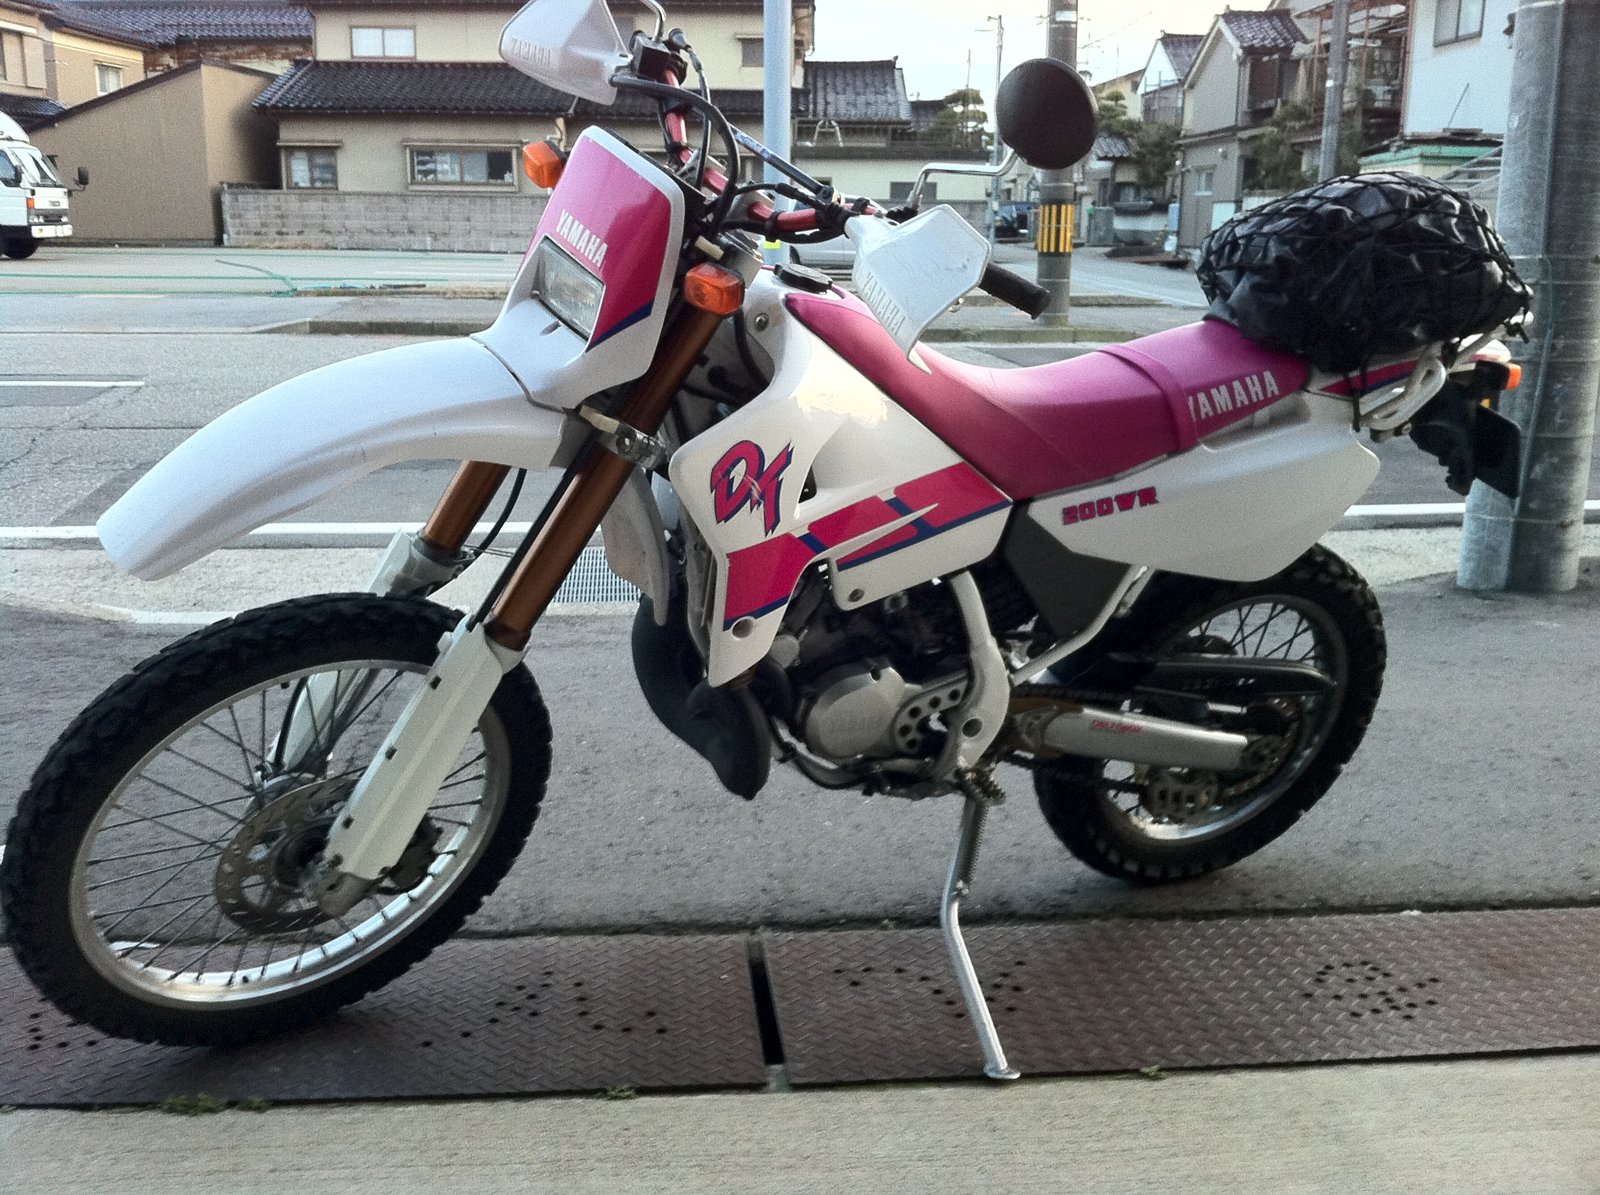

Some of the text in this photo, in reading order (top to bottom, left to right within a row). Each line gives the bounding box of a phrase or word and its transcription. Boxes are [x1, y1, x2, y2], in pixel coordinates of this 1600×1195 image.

[556, 204, 608, 268] YAMAHA
[861, 271, 906, 337] YAMAHA
[710, 439, 794, 537] DT
[1062, 486, 1159, 525] 200WR
